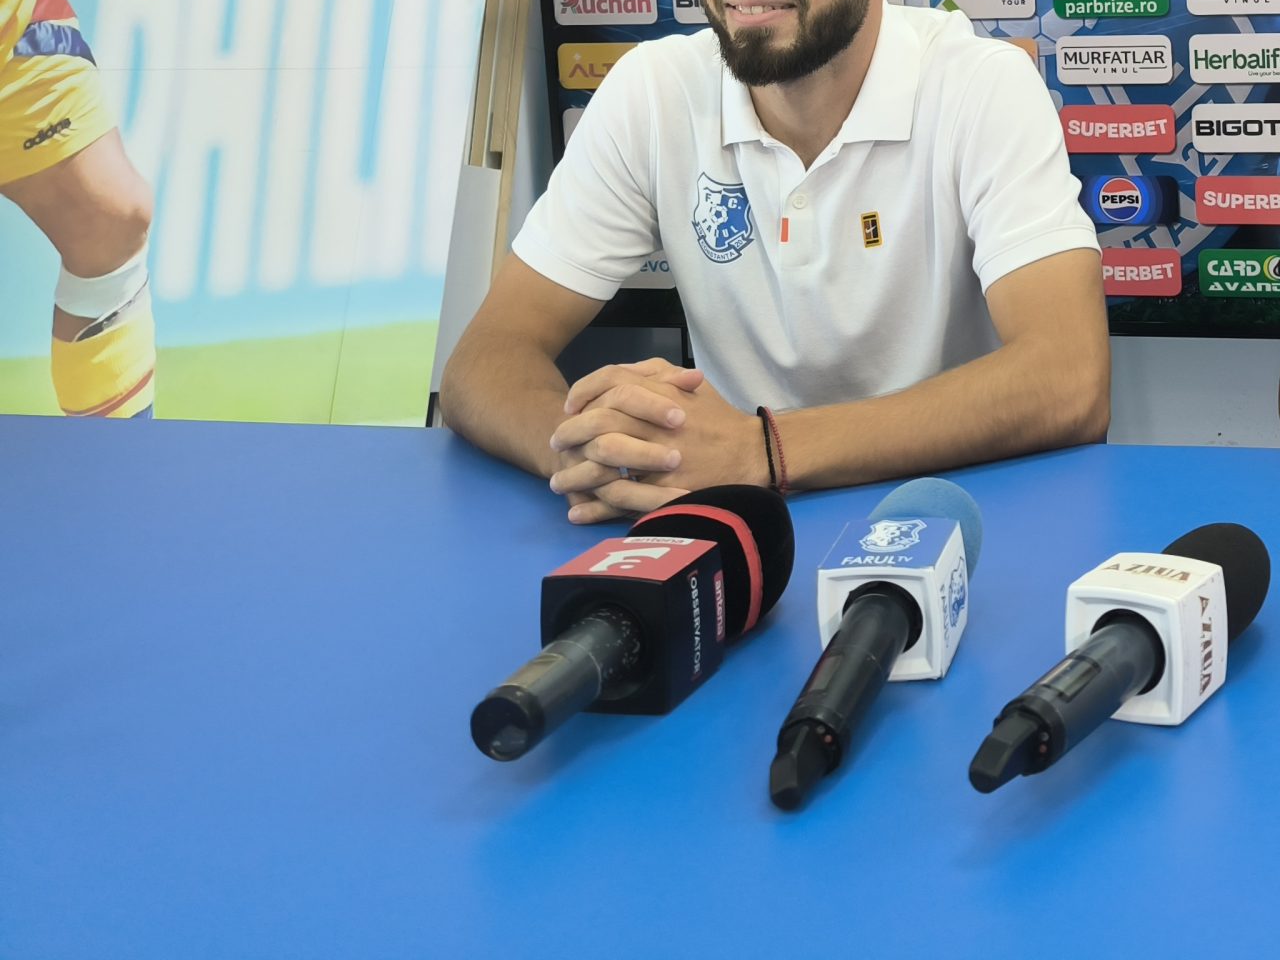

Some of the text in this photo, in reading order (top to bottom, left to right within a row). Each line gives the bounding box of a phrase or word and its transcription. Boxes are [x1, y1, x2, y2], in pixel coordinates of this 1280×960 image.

[1063, 50, 1165, 65] MURFATLAR
[1067, 118, 1168, 138] SUPERBET
[1101, 194, 1140, 205] PEPSI
[1101, 262, 1175, 282] PERBET
[841, 555, 914, 566] FARUL TV
